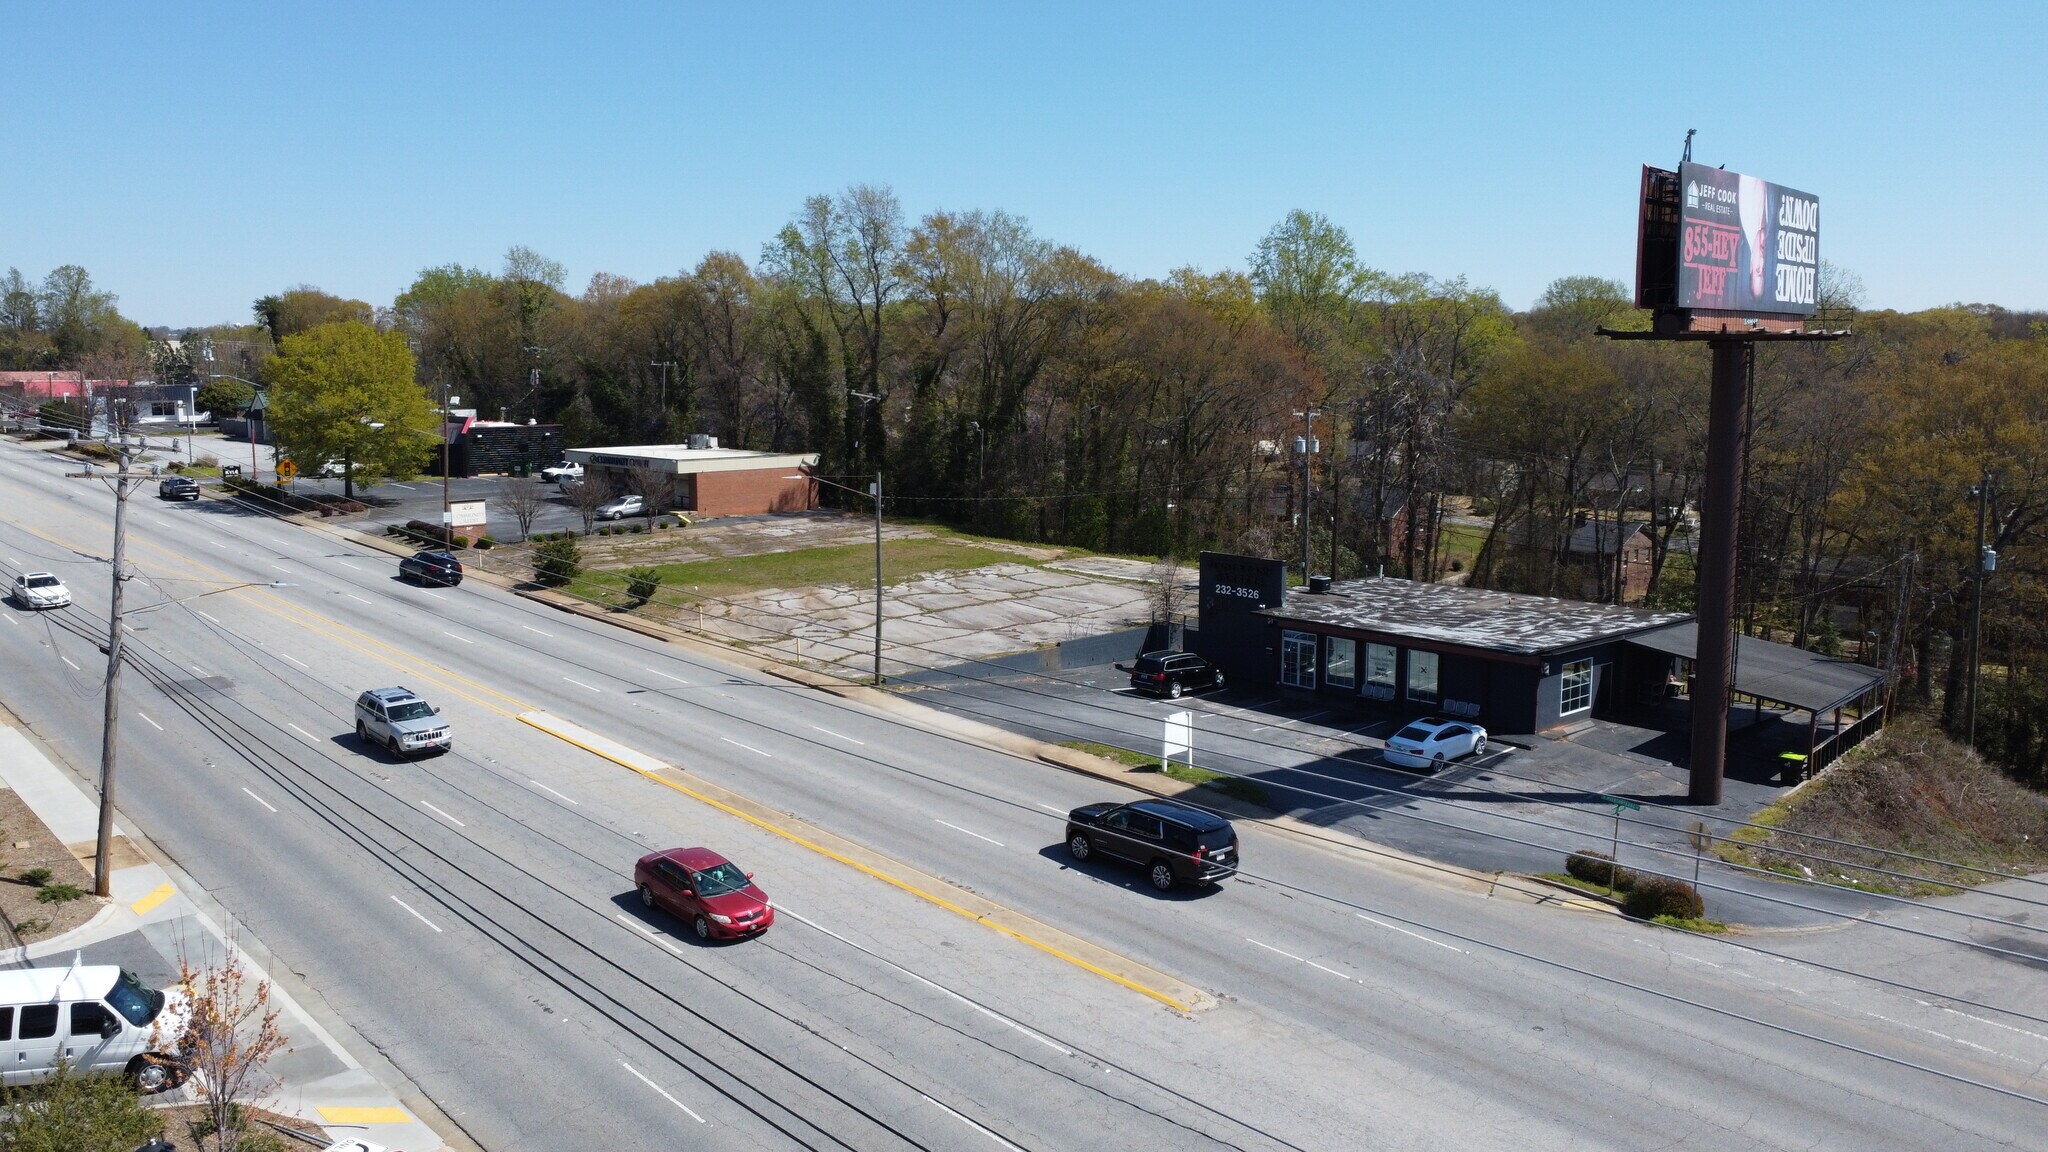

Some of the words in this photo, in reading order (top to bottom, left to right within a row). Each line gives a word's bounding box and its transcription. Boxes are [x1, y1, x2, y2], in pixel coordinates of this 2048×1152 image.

[1699, 184, 1715, 200] JEFF
[1718, 188, 1737, 204] COOK
[1704, 201, 1716, 213] REAL
[1716, 204, 1731, 216] ESTATE
[1779, 194, 1818, 232] DOWN?
[1684, 225, 1739, 267] 855-HEY
[1778, 230, 1815, 264] UPSIDE
[1696, 263, 1727, 300] JEFF
[1775, 263, 1816, 304] HOME
[1215, 584, 1260, 599] 232-3526
[330, 1139, 355, 1152] ONL
